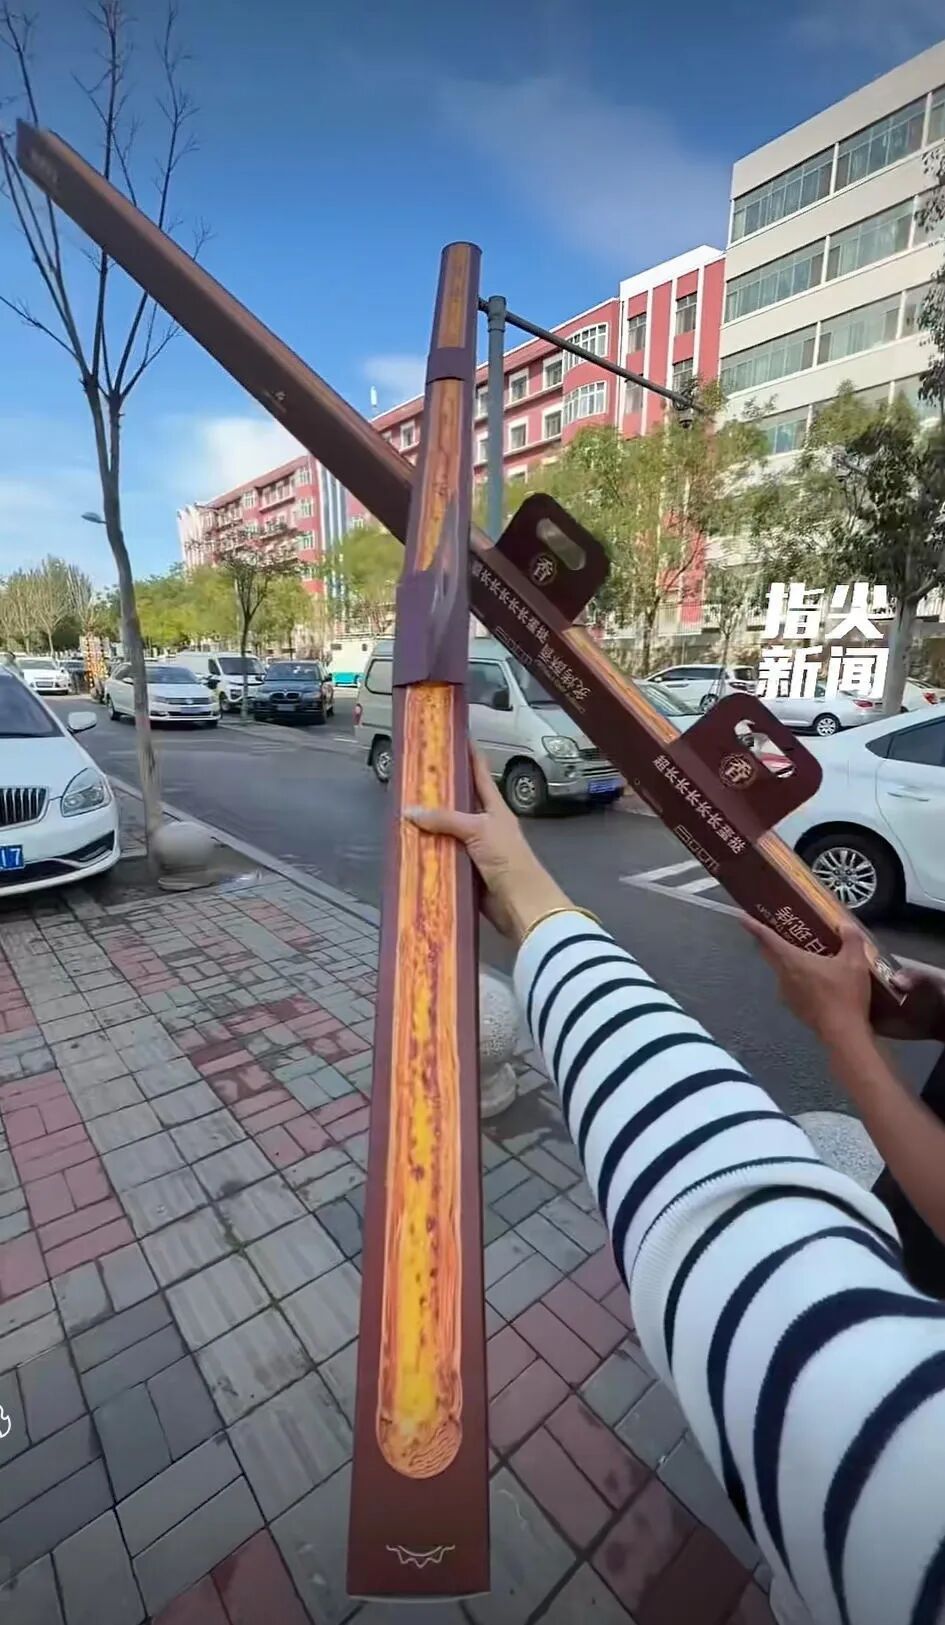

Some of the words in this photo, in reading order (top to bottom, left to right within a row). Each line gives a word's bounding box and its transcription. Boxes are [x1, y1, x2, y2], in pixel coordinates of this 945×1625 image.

[652, 755, 746, 854] 超长长长长长蛋挞
